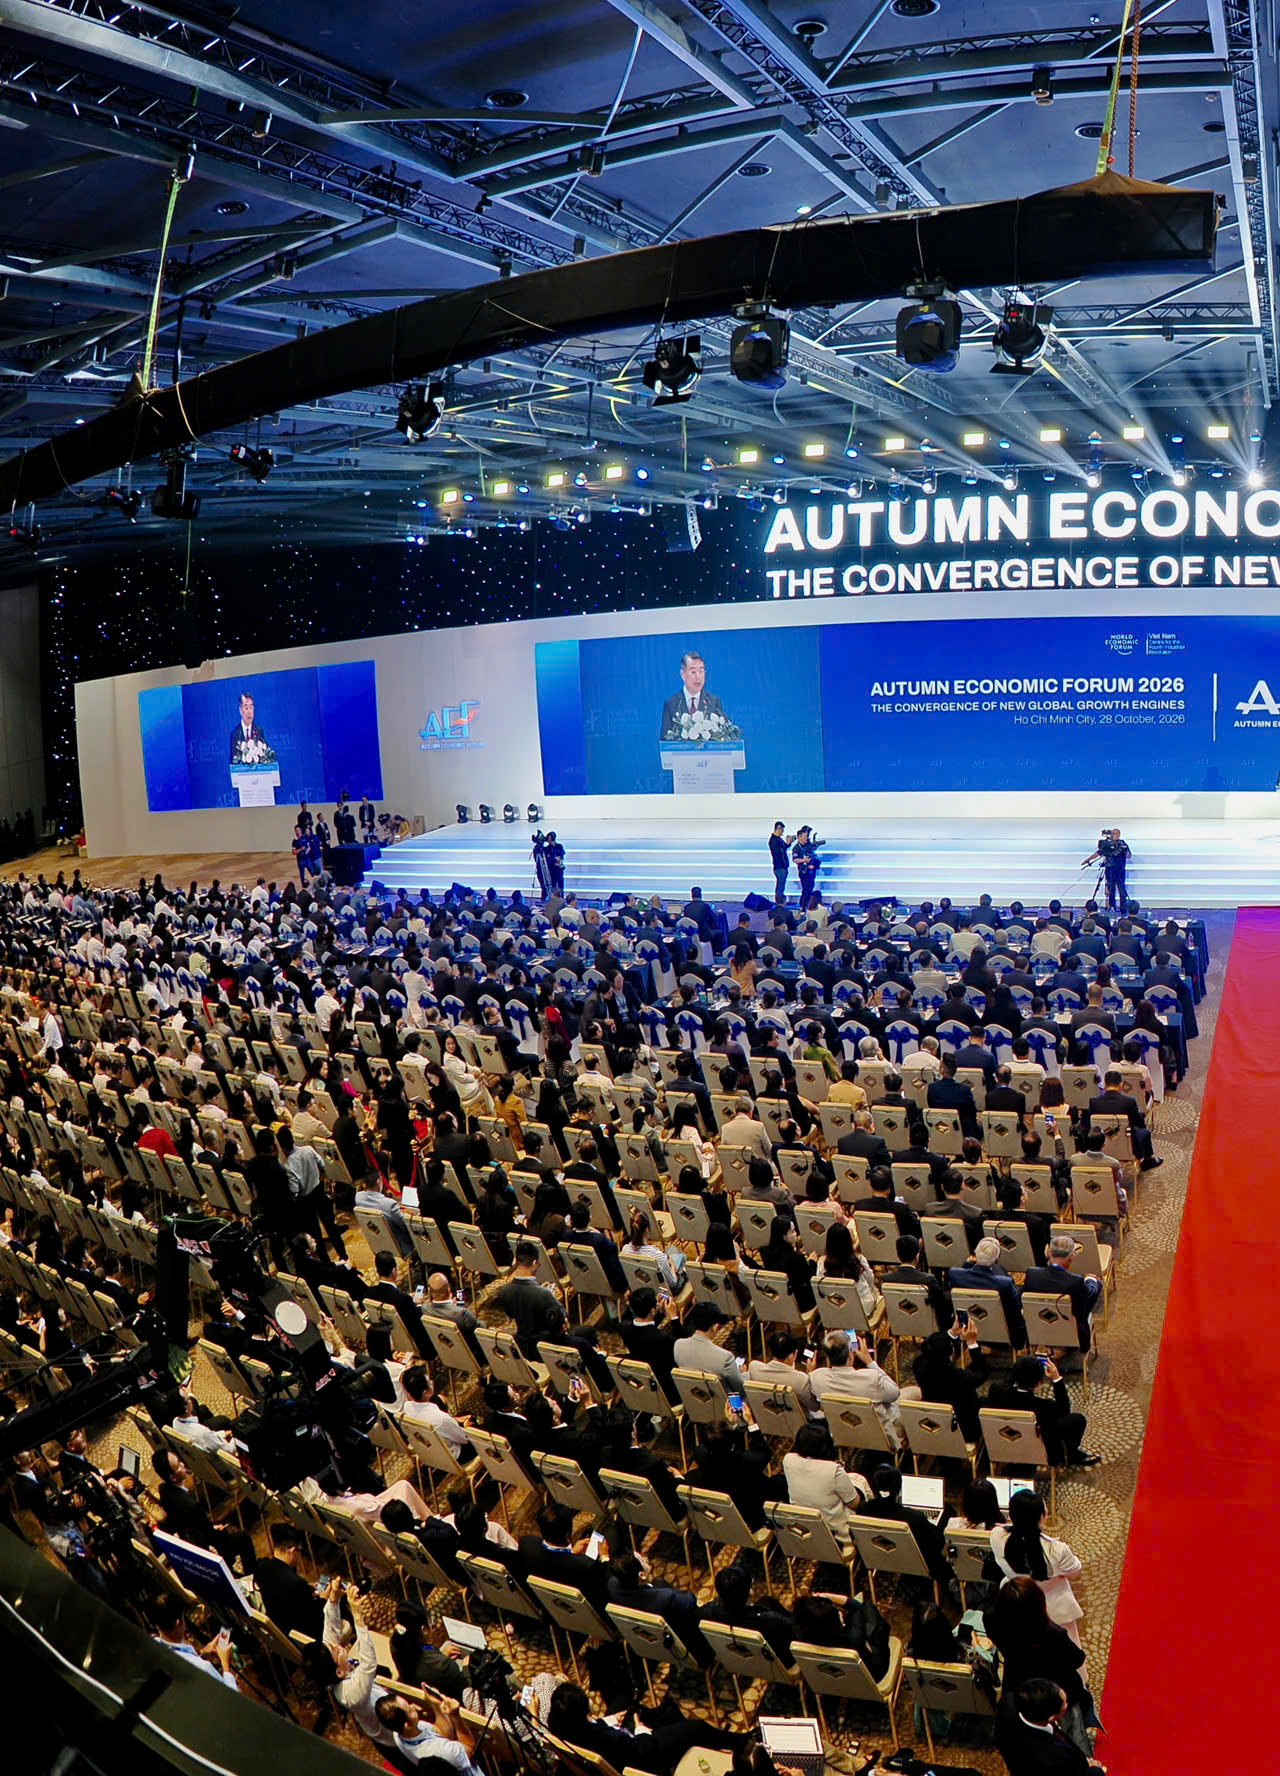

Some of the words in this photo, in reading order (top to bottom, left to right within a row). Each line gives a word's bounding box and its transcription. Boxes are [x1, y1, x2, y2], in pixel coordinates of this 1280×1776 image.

[763, 494, 1029, 553] AUTUMN
[766, 567, 835, 598] THE
[842, 556, 1139, 594] CONVERGENCE
[1149, 556, 1205, 585] OF
[871, 680, 950, 697] AUTUMN
[953, 678, 1059, 695] ECONOMIC
[1062, 677, 1134, 693] FORUM
[1138, 677, 1185, 693] 2026
[871, 703, 893, 713] THE
[894, 702, 980, 713] CONVERGENCE
[982, 701, 998, 711] OF
[1000, 701, 1026, 711] NEW
[1028, 701, 1075, 711] GLOBAL
[1076, 700, 1130, 710] GROWTH
[1132, 700, 1185, 710] ENGINES
[1014, 715, 1029, 725] Ho
[1030, 714, 1048, 725] Chi
[1050, 714, 1074, 725] Minh
[1076, 714, 1097, 726] City,
[1099, 714, 1113, 724] 28
[1114, 714, 1157, 725] October,
[1158, 714, 1185, 724] 2026
[1234, 720, 1271, 728] AUTUMN
